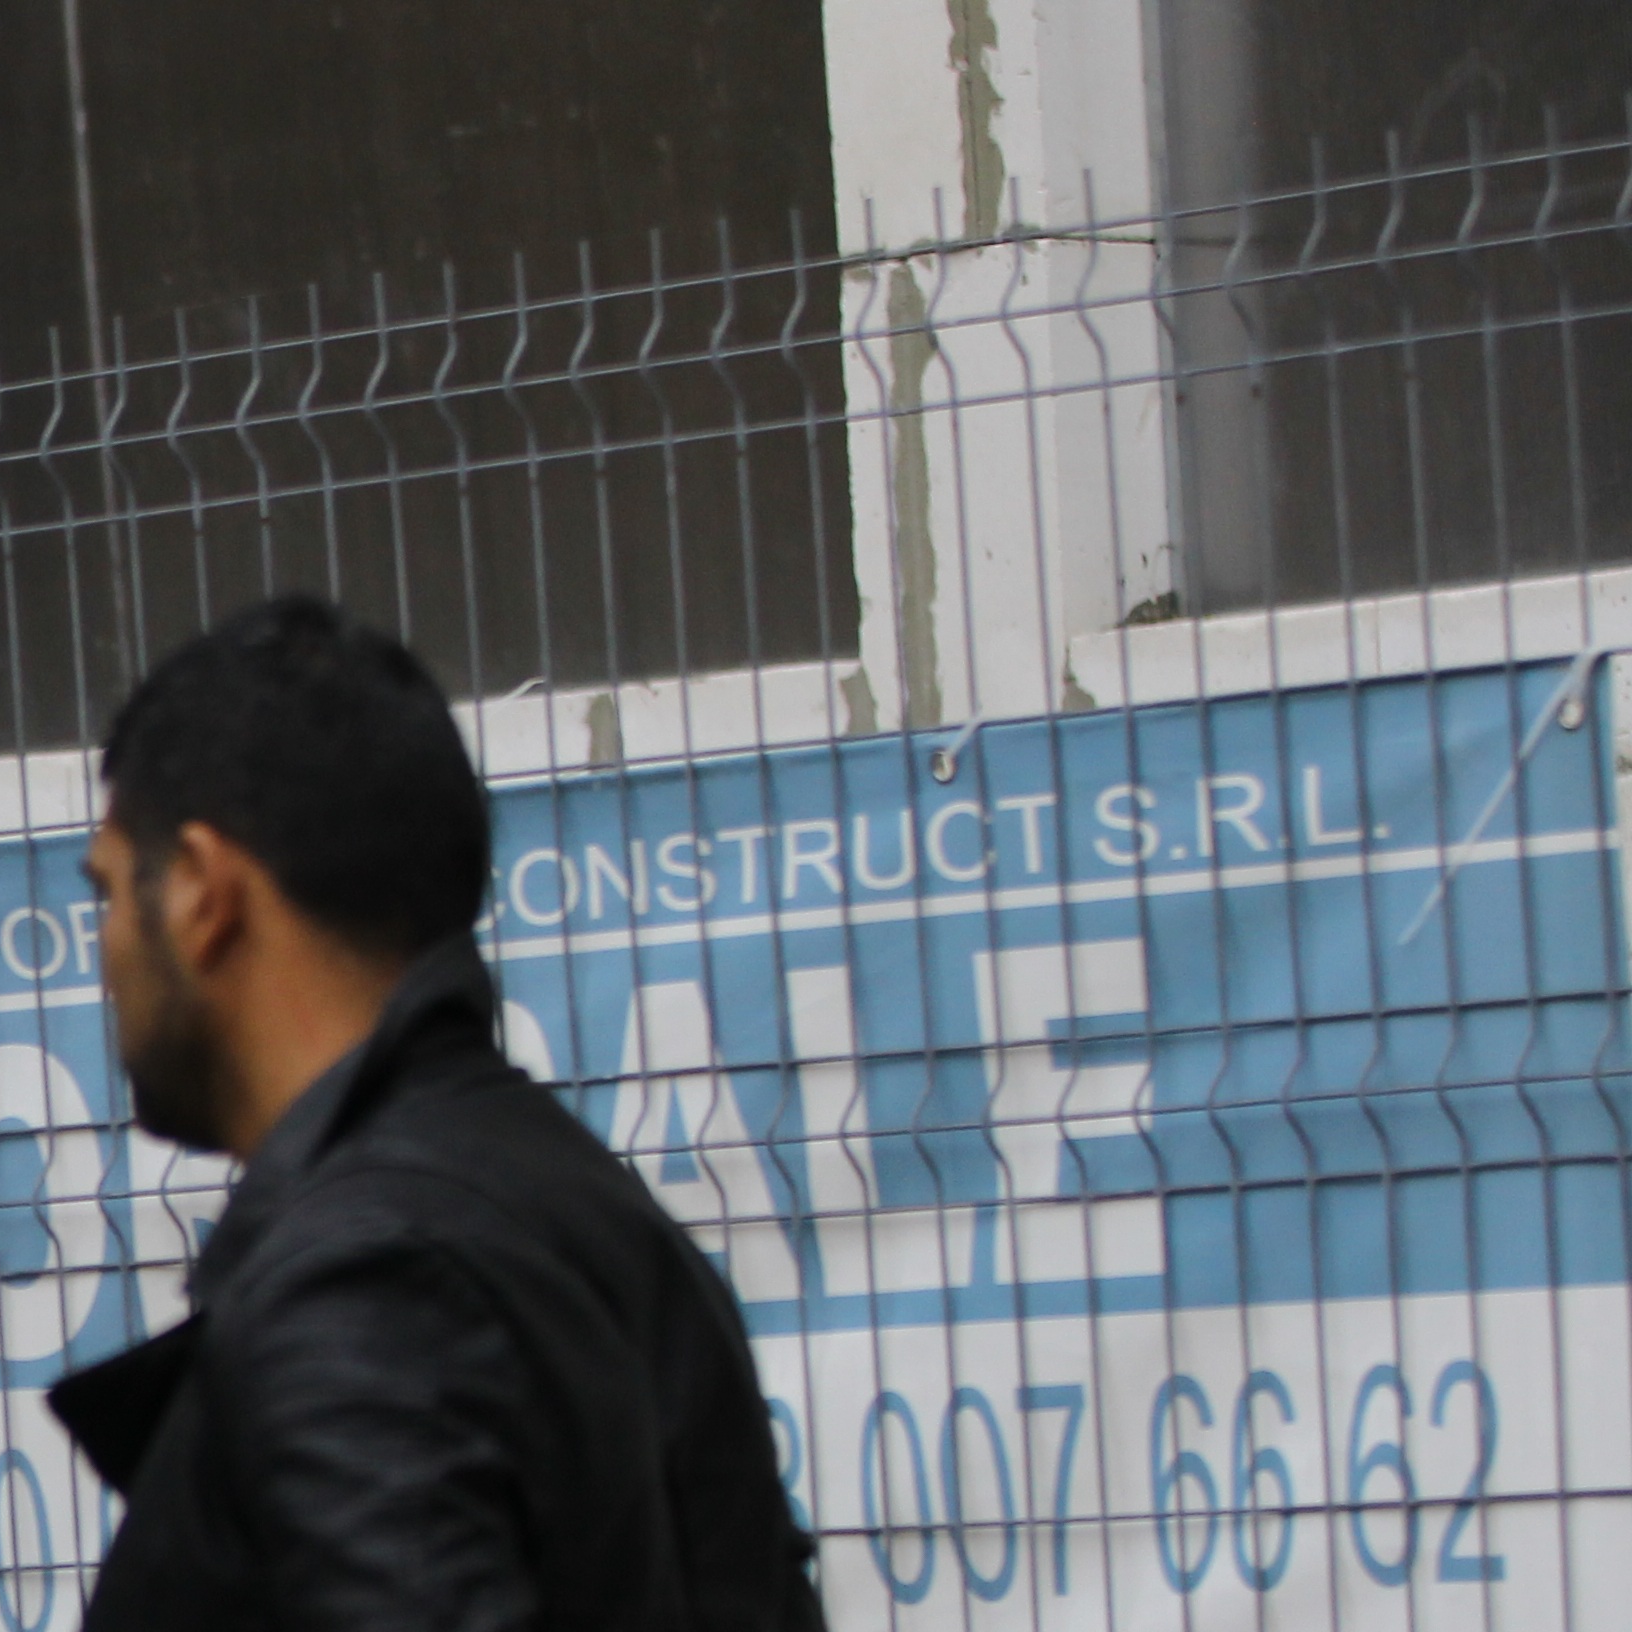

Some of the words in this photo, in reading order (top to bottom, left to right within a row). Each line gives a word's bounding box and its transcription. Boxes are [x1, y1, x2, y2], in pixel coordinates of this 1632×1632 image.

[472, 795, 1058, 933] ONSTRUCT
[1093, 766, 1392, 867] S.R.L.
[495, 937, 1167, 1302] ALE
[860, 1383, 1085, 1606] 007
[1150, 1370, 1297, 1594] 66
[1346, 1360, 1507, 1588] 62
